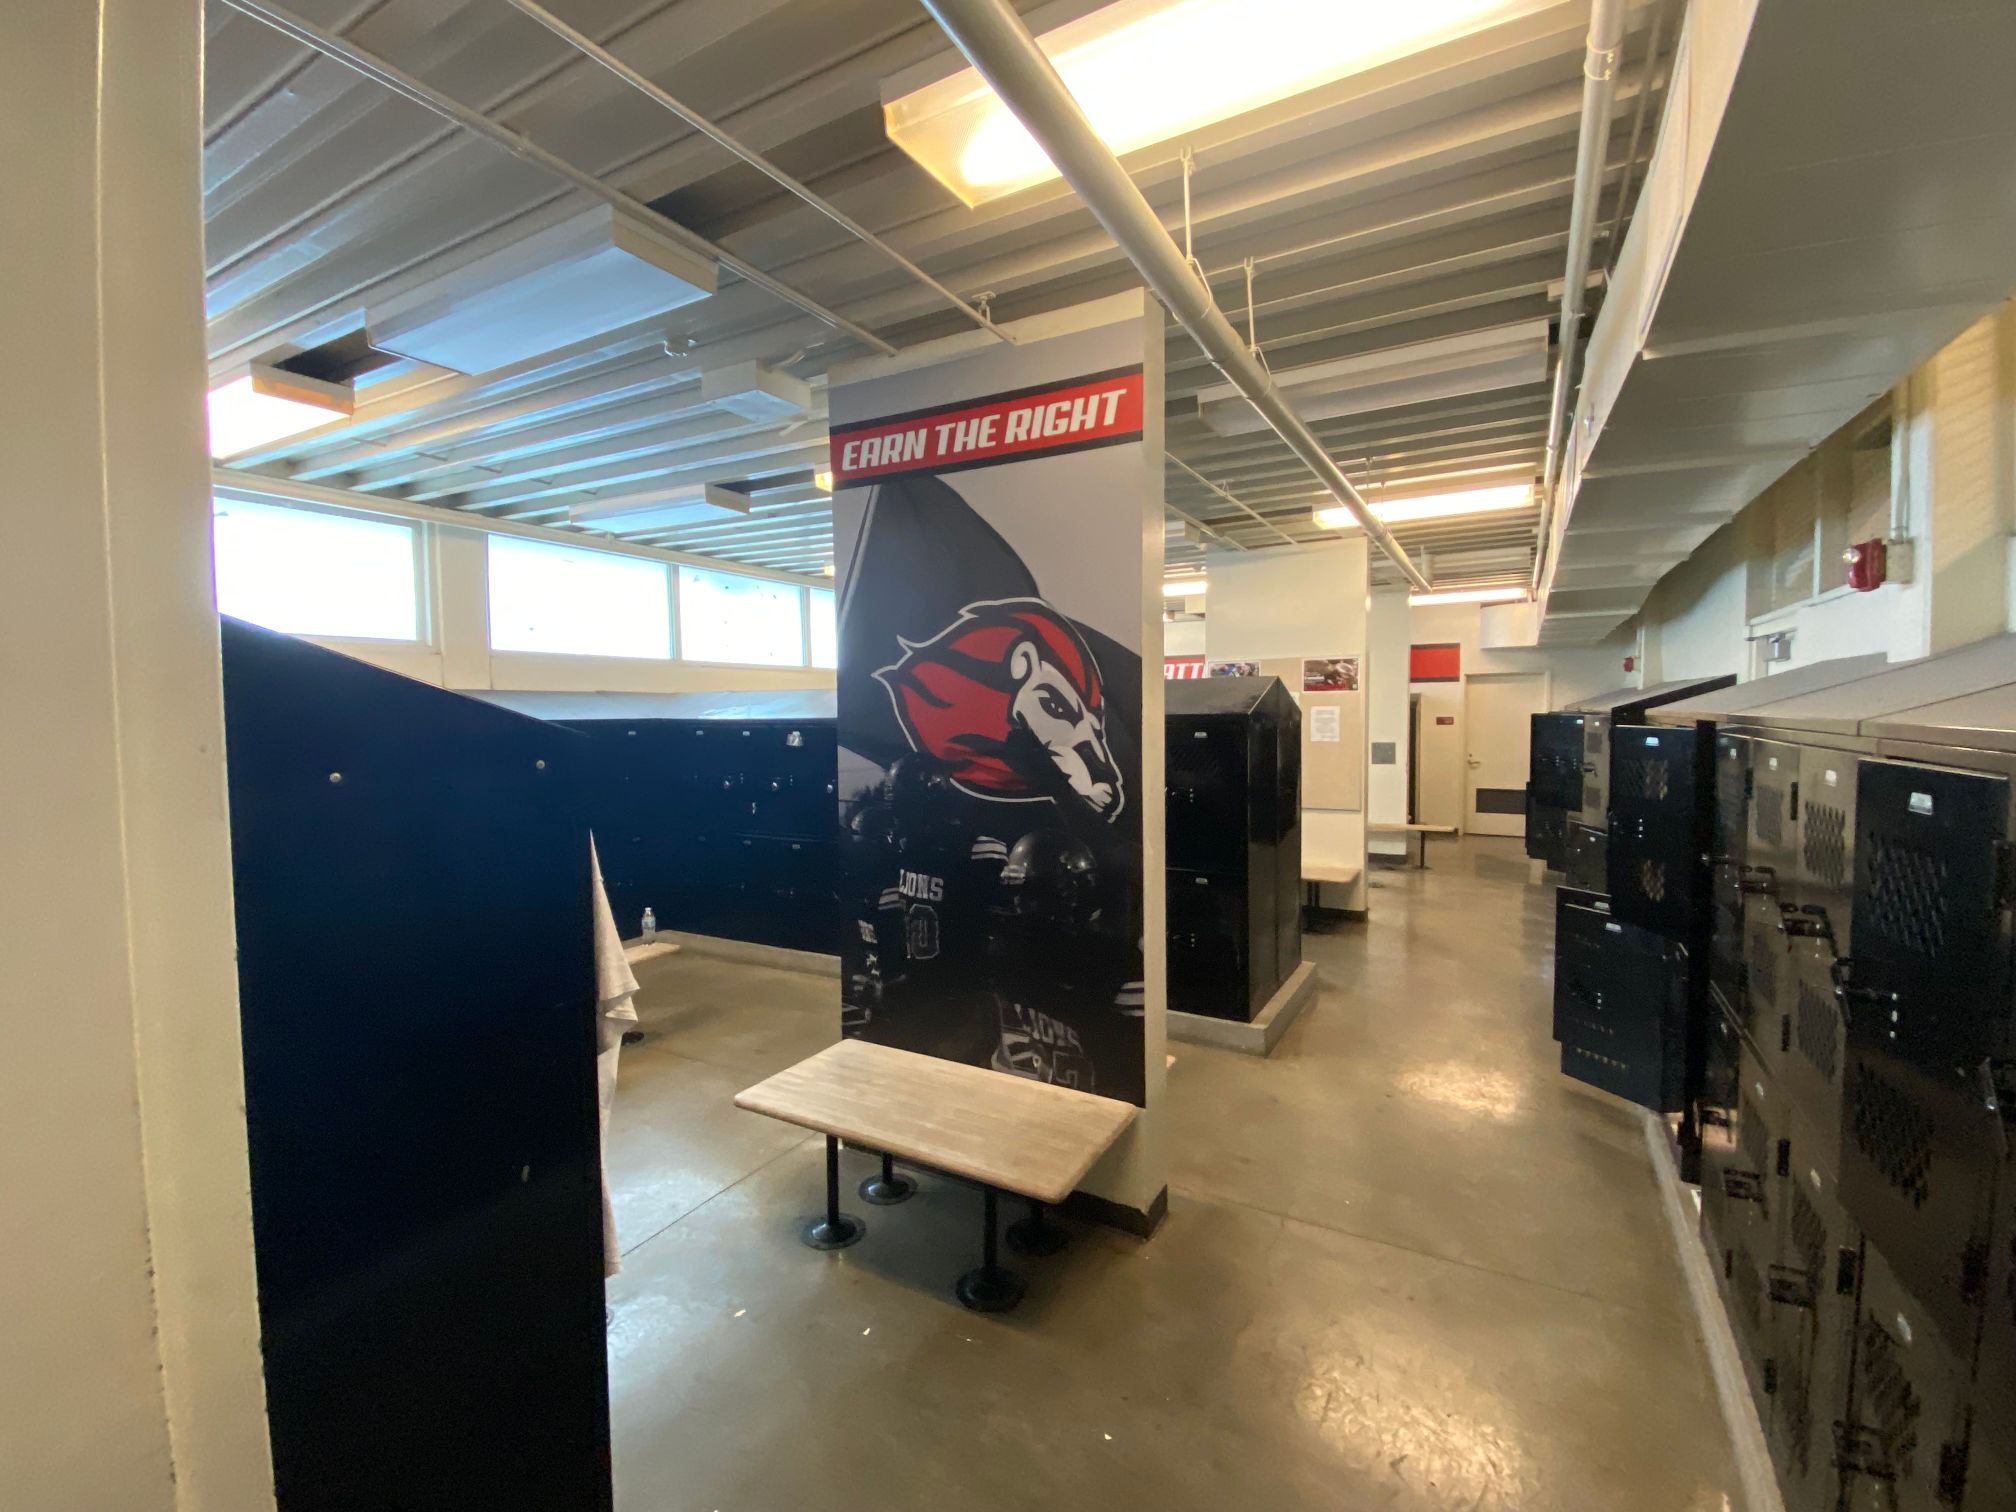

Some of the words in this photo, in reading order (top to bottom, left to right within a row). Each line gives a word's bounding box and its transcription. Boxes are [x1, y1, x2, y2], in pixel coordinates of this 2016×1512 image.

[842, 428, 927, 471] EARN
[935, 414, 1000, 456] THE
[1004, 388, 1127, 444] RIGHT
[1164, 662, 1205, 680] ATT
[899, 868, 944, 901] LIONS
